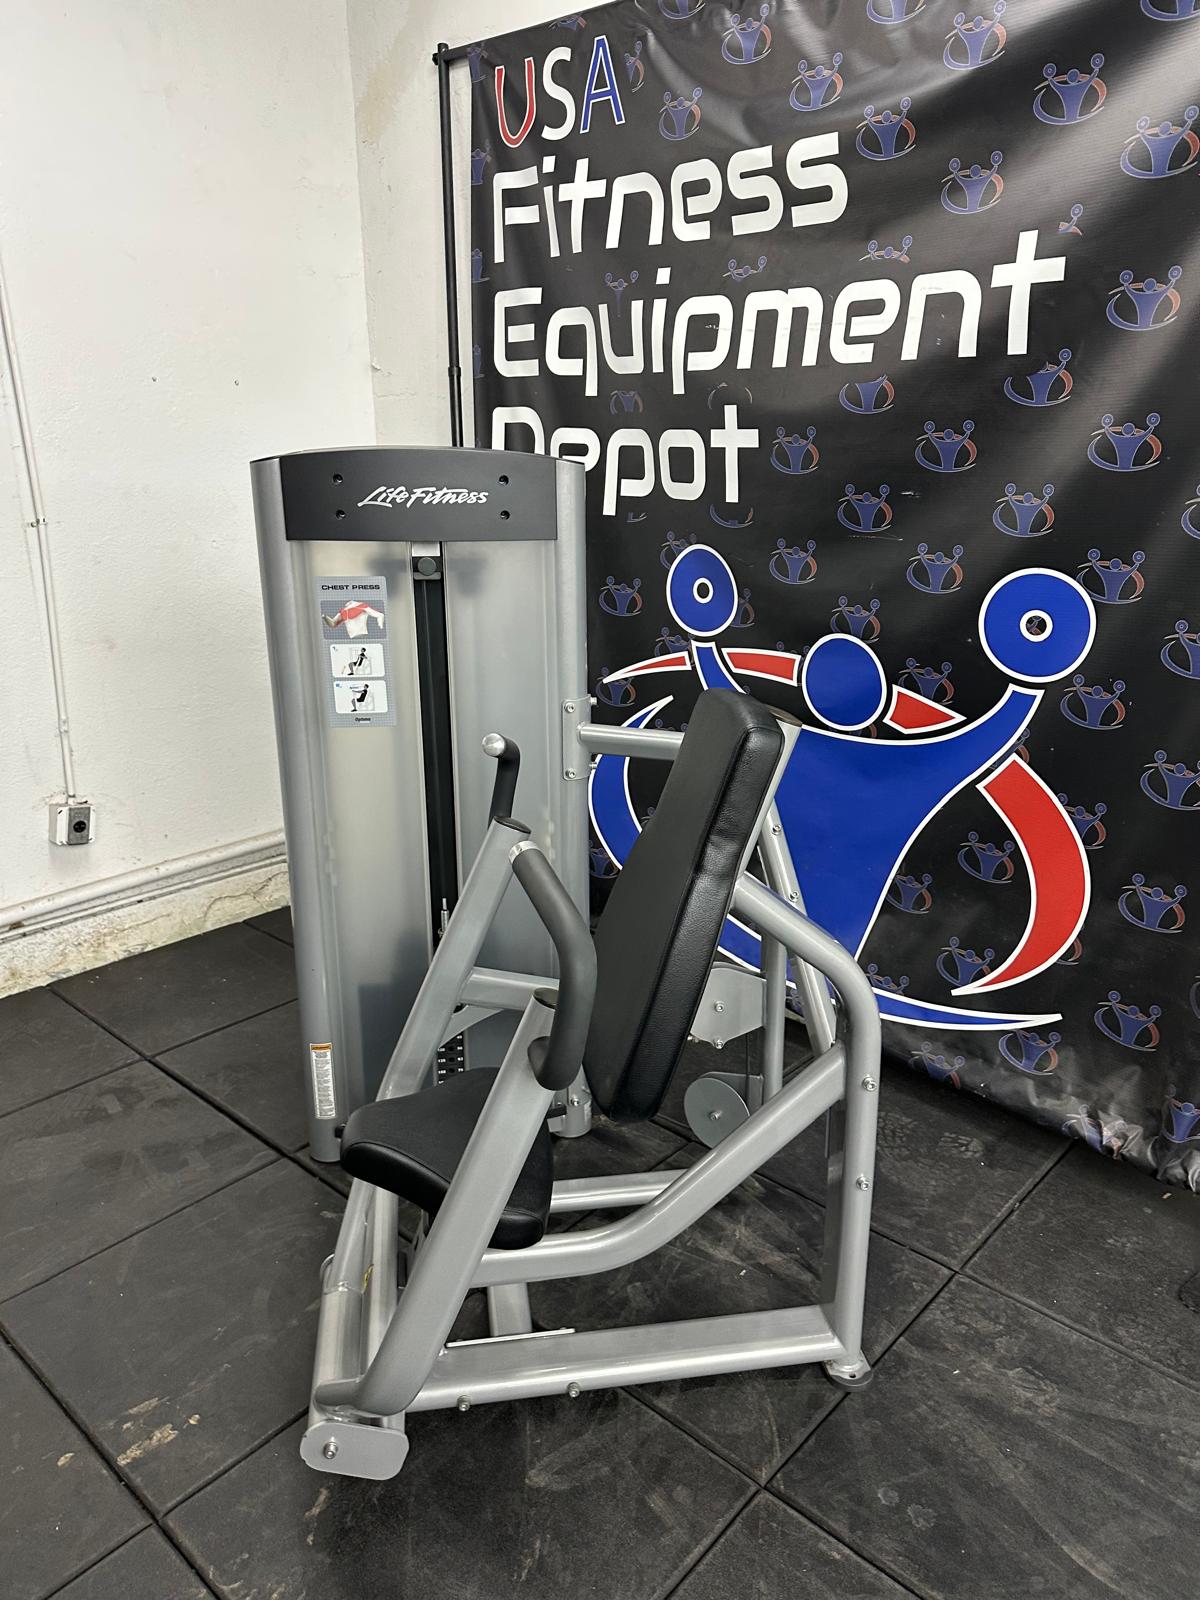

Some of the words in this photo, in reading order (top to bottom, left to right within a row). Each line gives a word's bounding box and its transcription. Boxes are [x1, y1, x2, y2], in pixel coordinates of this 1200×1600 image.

[494, 35, 626, 148] USA
[493, 132, 849, 264] Fitness
[494, 230, 1066, 397] Equipment
[357, 485, 410, 508] Life
[406, 486, 489, 508] Fitness
